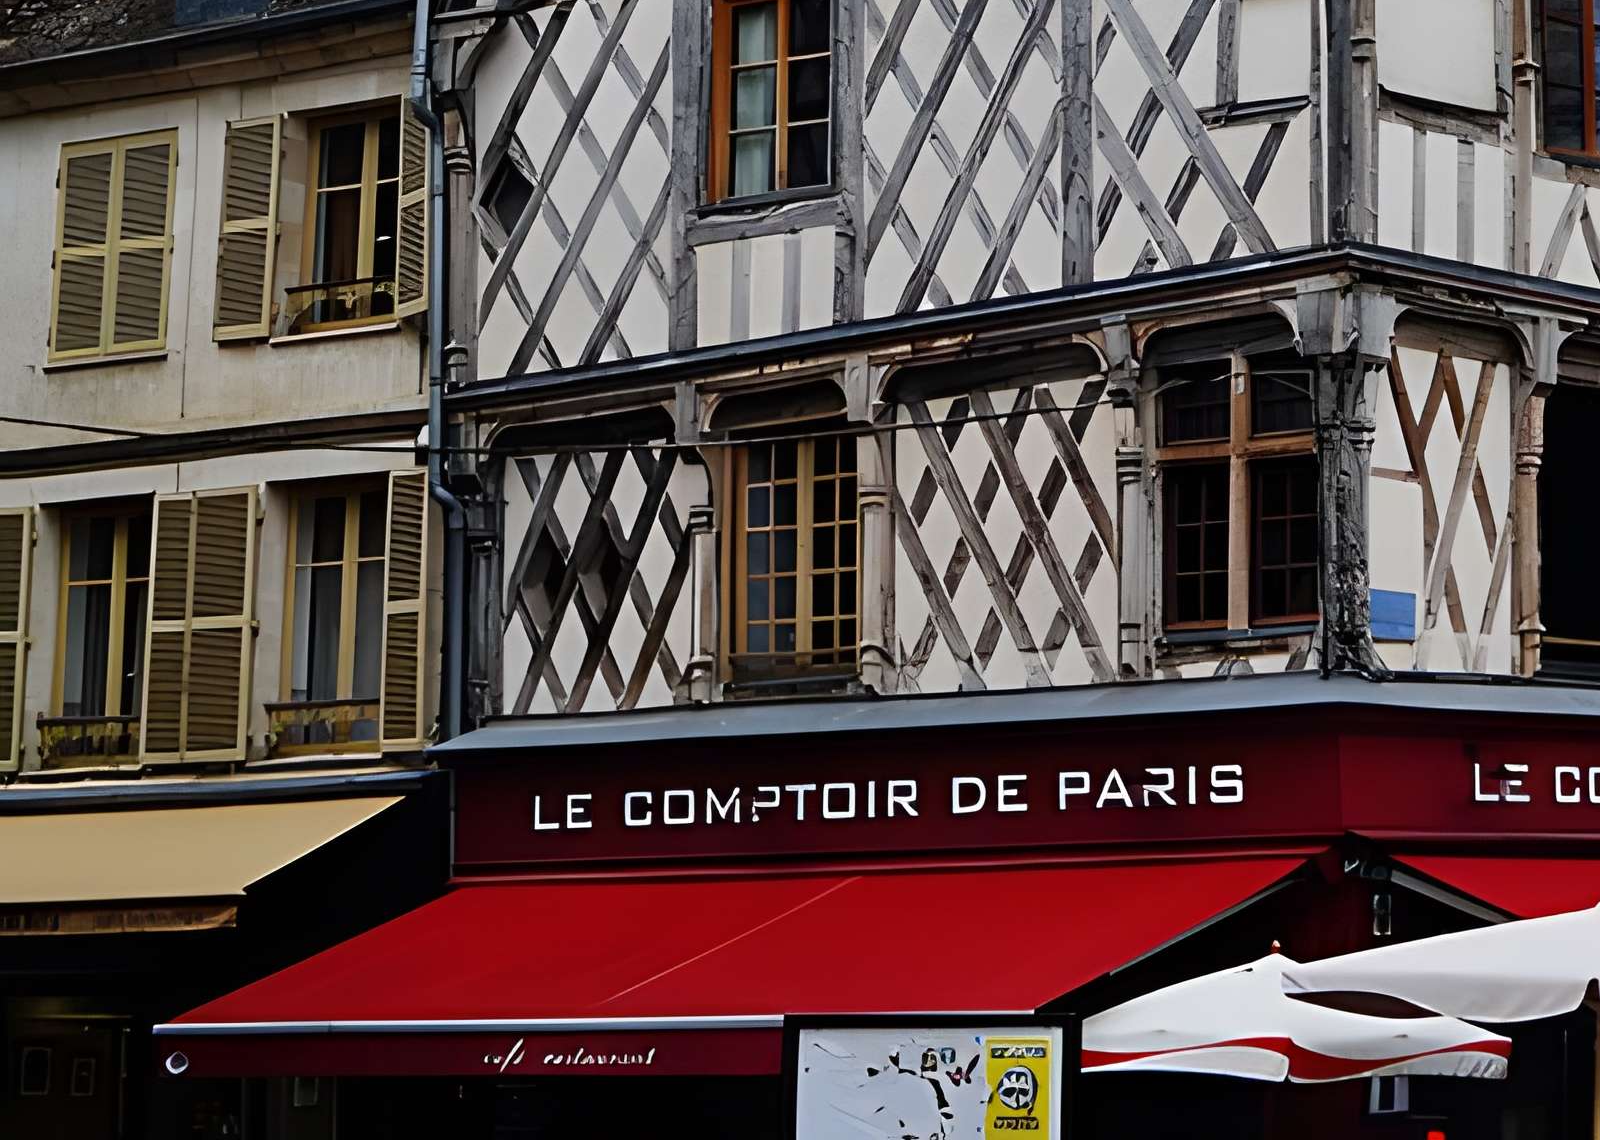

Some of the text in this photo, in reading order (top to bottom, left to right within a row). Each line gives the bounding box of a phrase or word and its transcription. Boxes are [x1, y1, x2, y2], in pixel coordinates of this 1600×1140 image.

[533, 764, 1244, 831] LE COMPTOIR DE PARIS
[1474, 762, 1531, 803] LE
